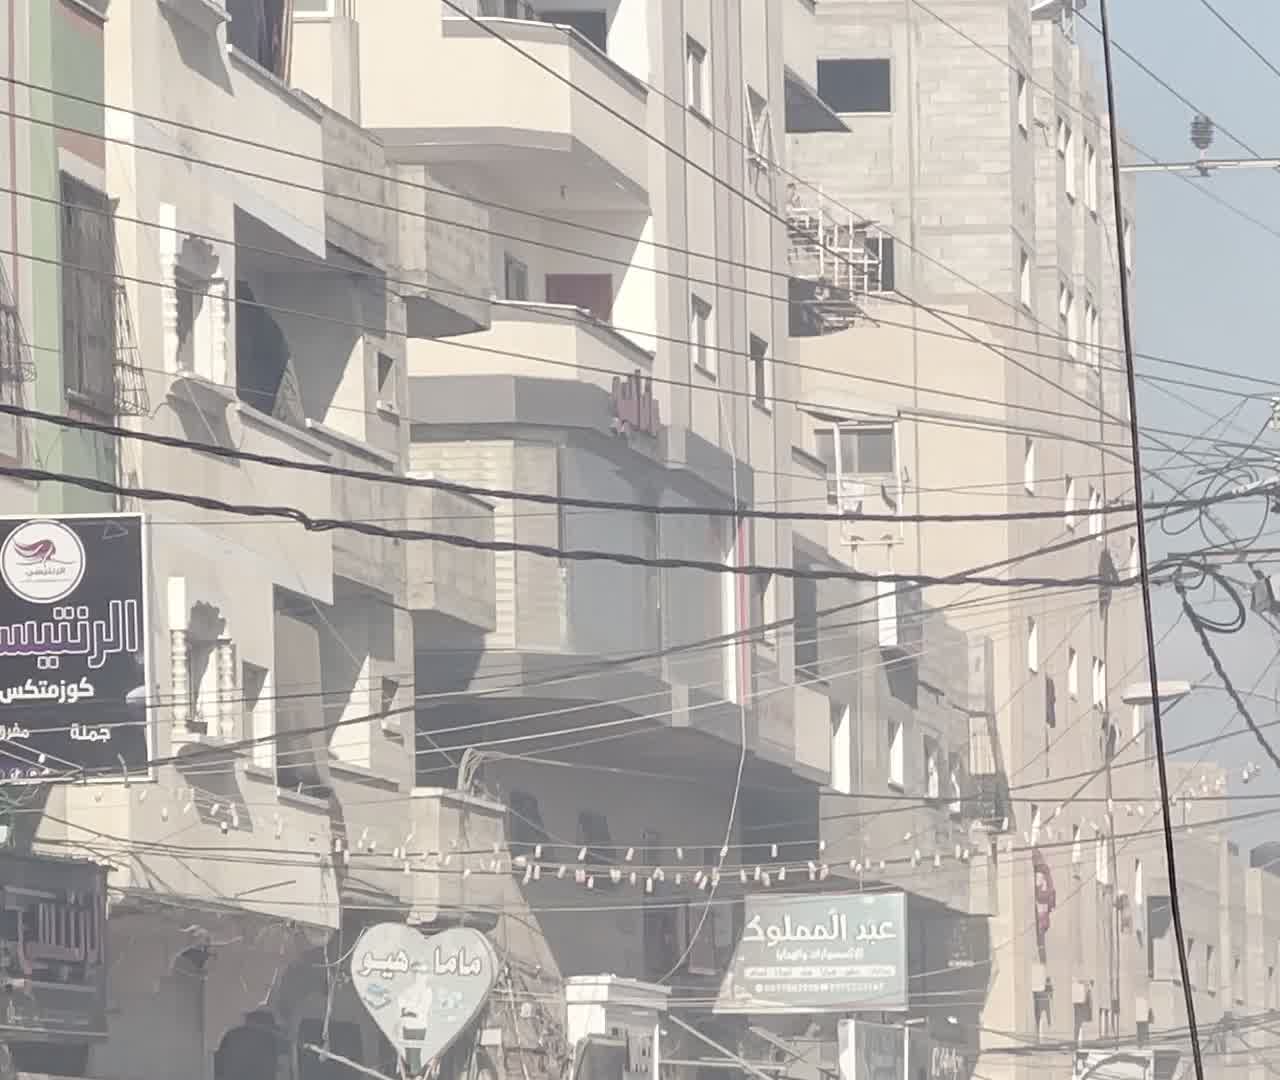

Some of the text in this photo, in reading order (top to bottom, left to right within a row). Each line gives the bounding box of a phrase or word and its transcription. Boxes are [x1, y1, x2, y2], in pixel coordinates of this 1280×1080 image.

[0, 599, 138, 669] الرنتيس
[0, 677, 95, 703] كوزمتكس
[70, 723, 111, 743] جملة
[856, 920, 897, 945] عبد
[434, 945, 482, 977] ماما
